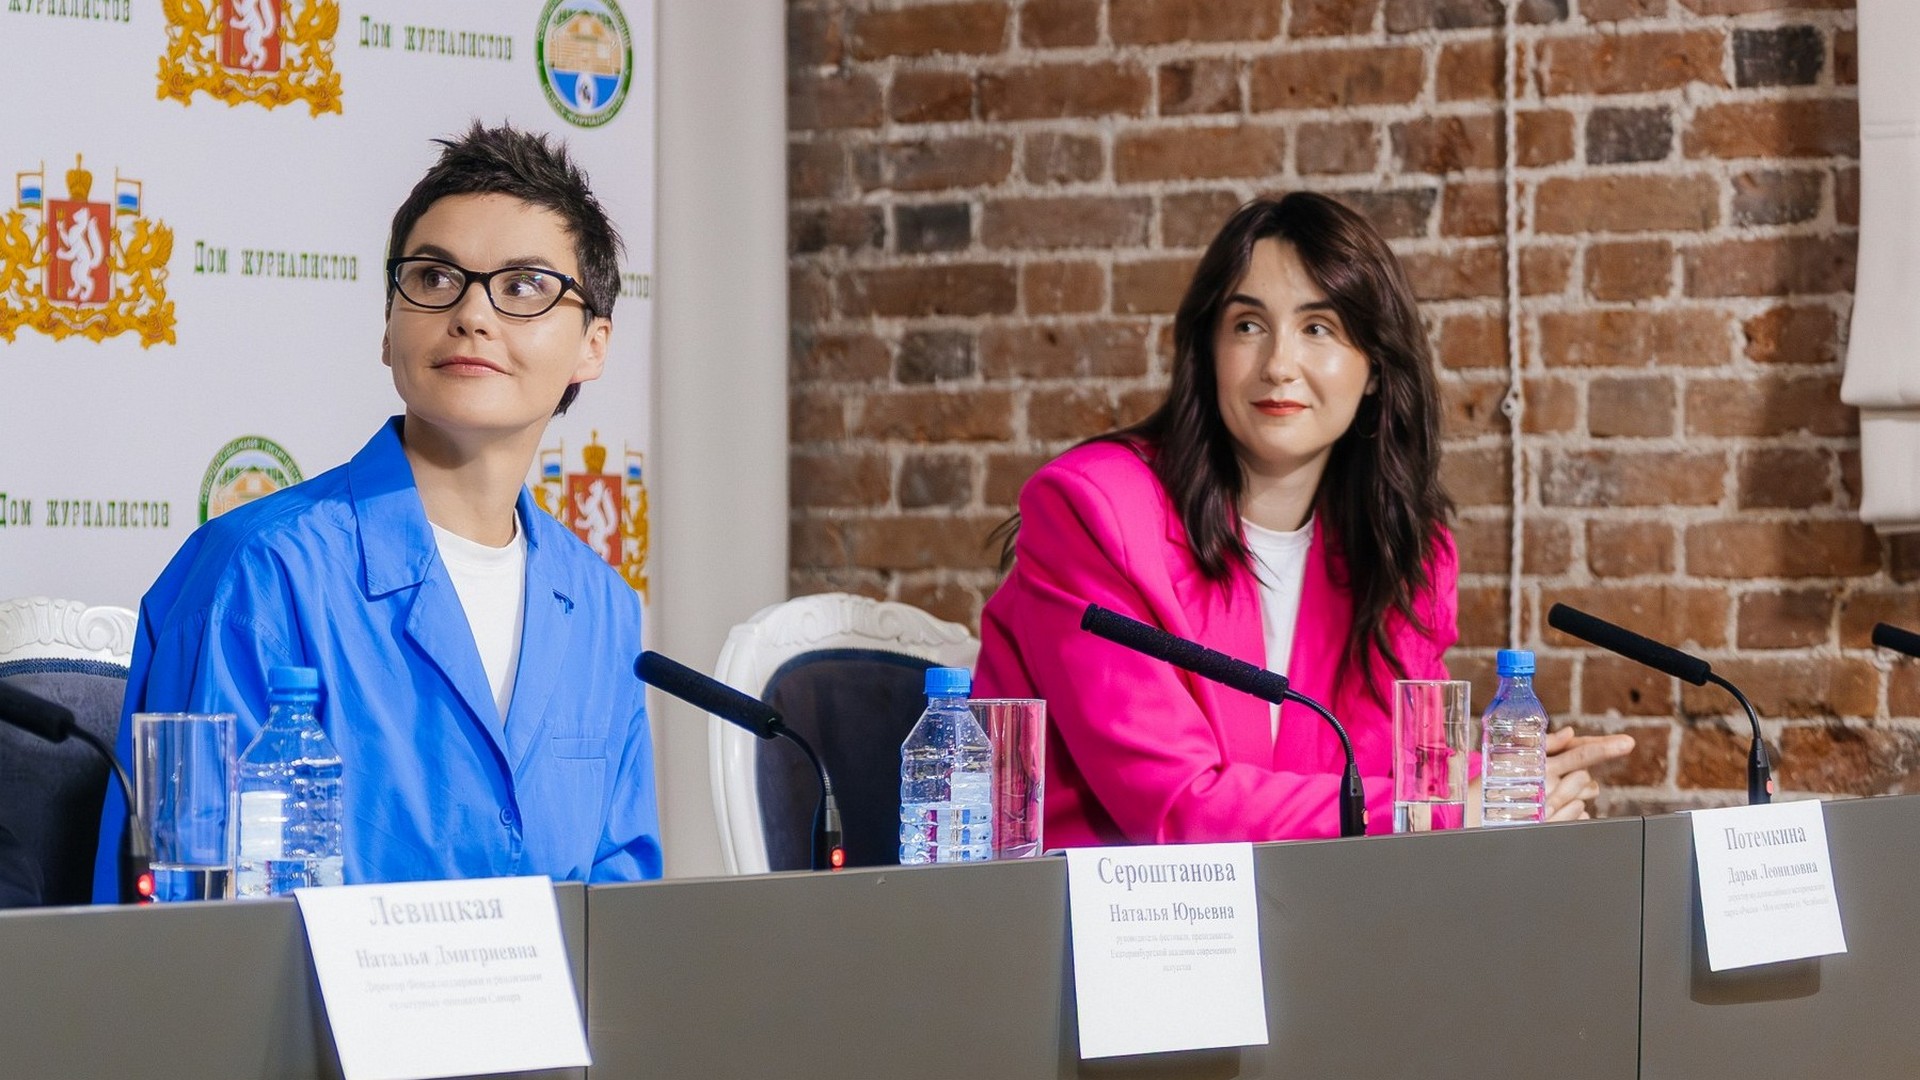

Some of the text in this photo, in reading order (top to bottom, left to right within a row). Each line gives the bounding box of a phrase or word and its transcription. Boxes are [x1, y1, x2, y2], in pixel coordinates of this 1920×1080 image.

[1725, 827, 1807, 850] Потемкина
[1097, 857, 1236, 891] Сероштанова
[1728, 861, 1818, 886] Дарья Леонидовна
[369, 896, 504, 925] Левицкая
[1109, 902, 1235, 925] Наталья Юрьевна
[355, 943, 538, 969] Наталья Дмитриевна
